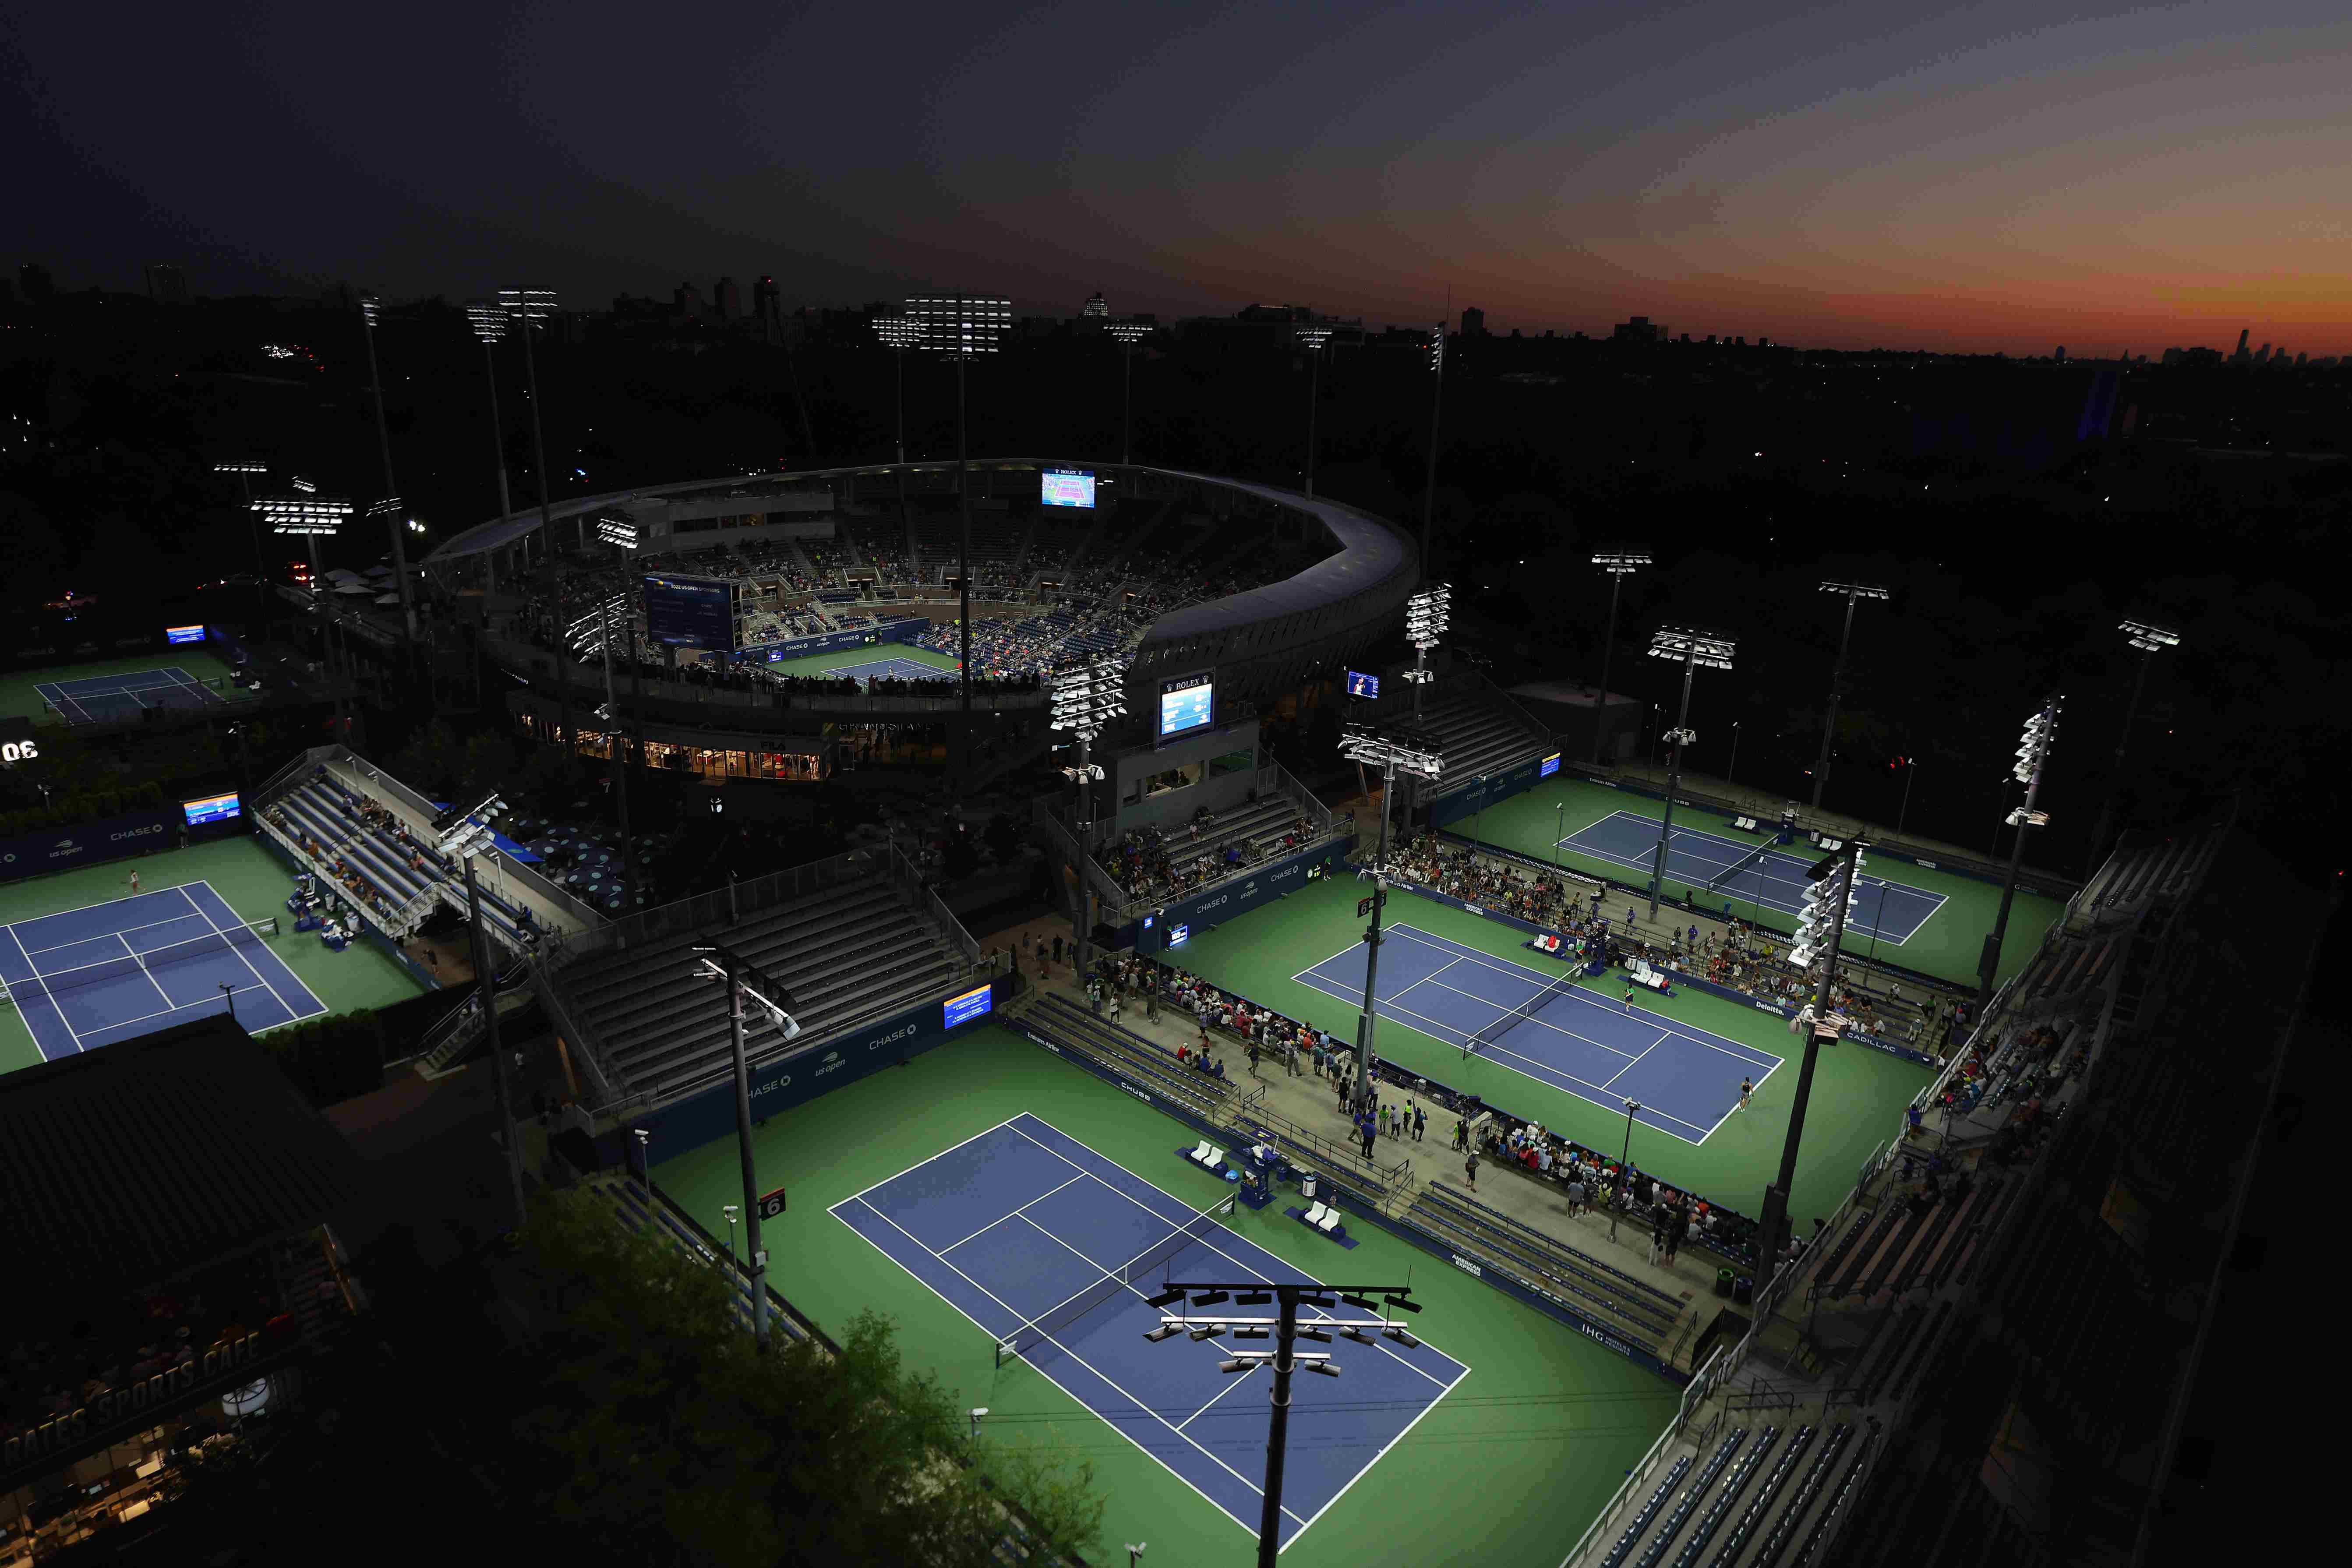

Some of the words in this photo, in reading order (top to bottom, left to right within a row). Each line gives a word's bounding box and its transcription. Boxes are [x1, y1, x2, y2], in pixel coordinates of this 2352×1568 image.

[1176, 678, 1200, 690] ROLEX
[110, 826, 152, 841] CHASE
[60, 846, 83, 856] open
[1271, 868, 1292, 882] CHASE
[1246, 887, 1258, 897] open
[1401, 883, 1414, 891] Airline
[1197, 898, 1220, 914] CHASE
[1361, 903, 1367, 915] 6
[1755, 1001, 1785, 1016] Deloitte.
[869, 1028, 905, 1051] CHASE
[1027, 1031, 1045, 1045] Emirates
[1045, 1040, 1060, 1053] Airline
[1847, 1032, 1896, 1052] CADILLAC
[815, 1067, 824, 1077] us
[825, 1058, 846, 1074] open
[1121, 1081, 1151, 1102] CHUBB
[767, 1198, 780, 1215] 6
[1451, 1254, 1482, 1272] AMERICAN
[1455, 1260, 1481, 1277] EXPRESS
[1582, 1323, 1603, 1342] IHG
[97, 1359, 196, 1423] SPORTS
